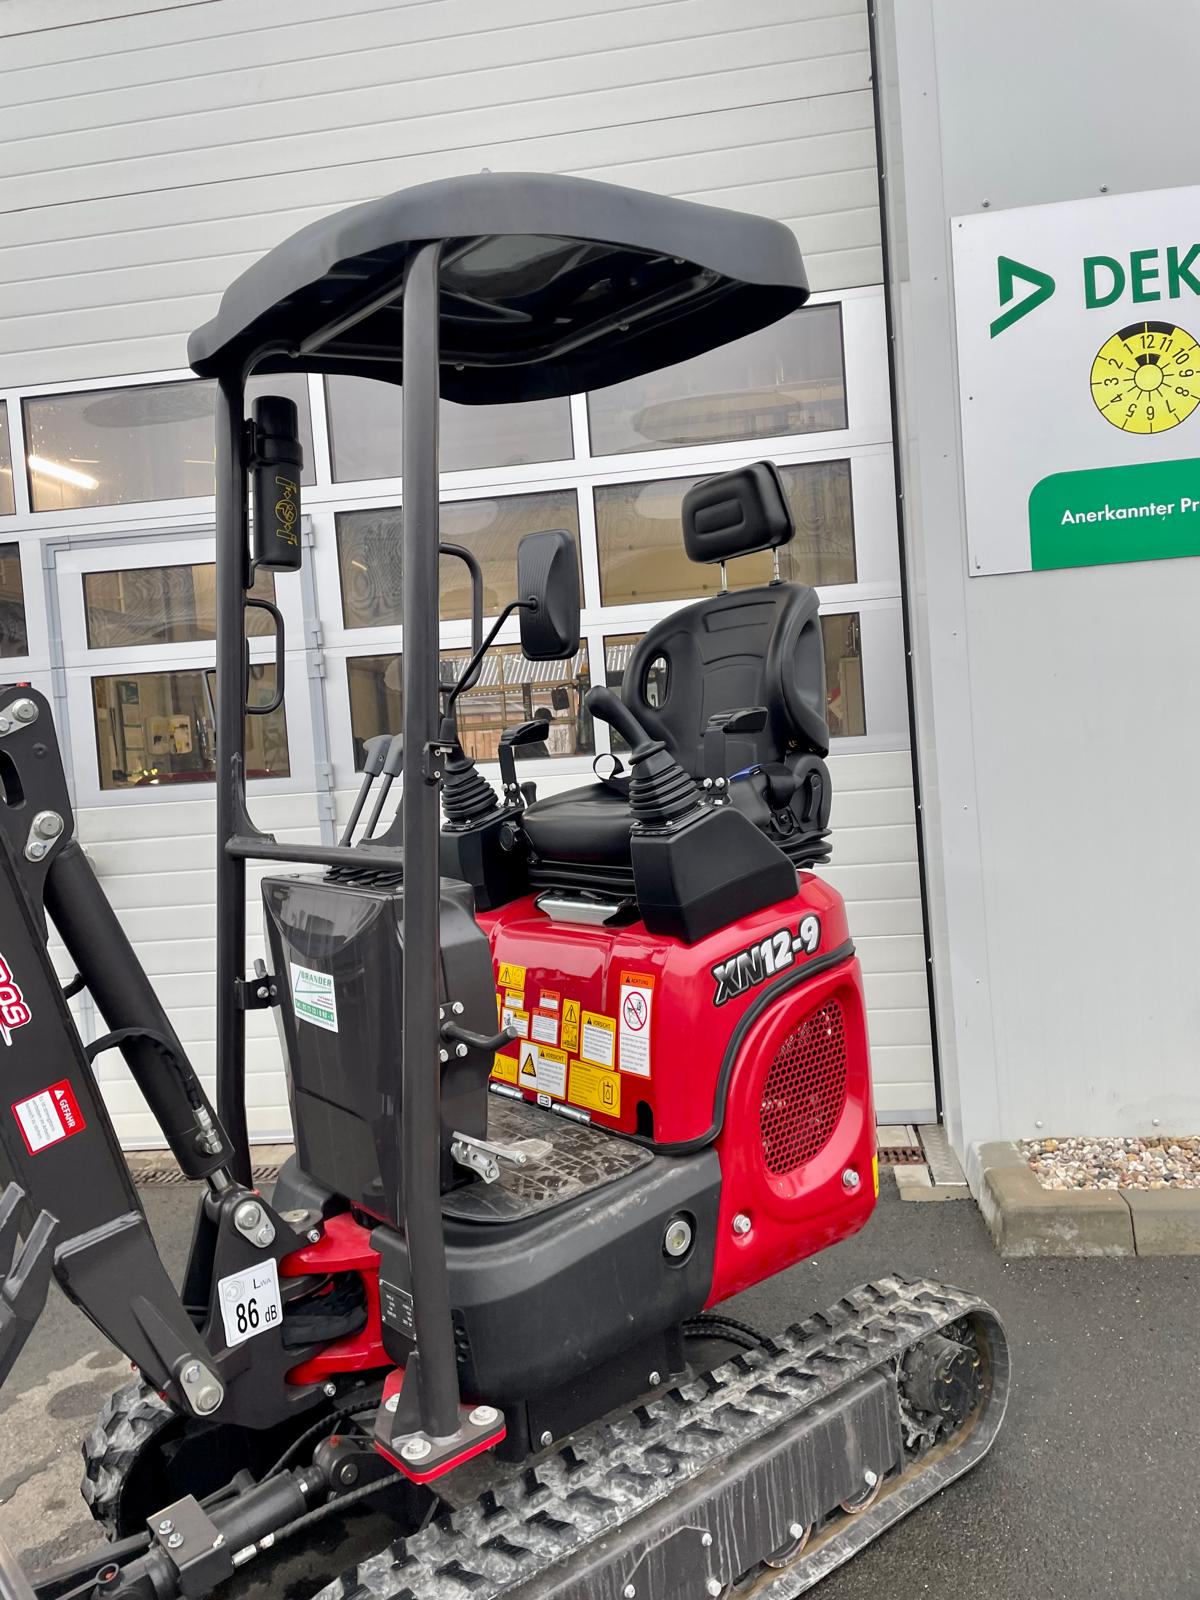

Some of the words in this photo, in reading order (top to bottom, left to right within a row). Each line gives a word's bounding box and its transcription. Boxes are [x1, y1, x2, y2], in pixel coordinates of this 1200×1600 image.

[1083, 243, 1200, 309] DEK
[1123, 343, 1133, 355] 1
[1140, 334, 1155, 349] 12
[1160, 336, 1173, 352] 11
[1108, 358, 1124, 369] 2
[1172, 348, 1190, 365] 10
[1179, 369, 1194, 378] 9
[1104, 377, 1119, 386] 3
[1110, 393, 1123, 403] 4
[1175, 386, 1190, 397] 8
[1125, 403, 1137, 418] 5
[1146, 405, 1155, 421] 6
[1166, 399, 1176, 413] 7
[1061, 502, 1175, 525] Anerkannter
[712, 913, 820, 1006] XN12-9
[59, 1099, 76, 1128] GEFAHR
[236, 1298, 260, 1334] 86
[264, 1304, 278, 1323] dB
